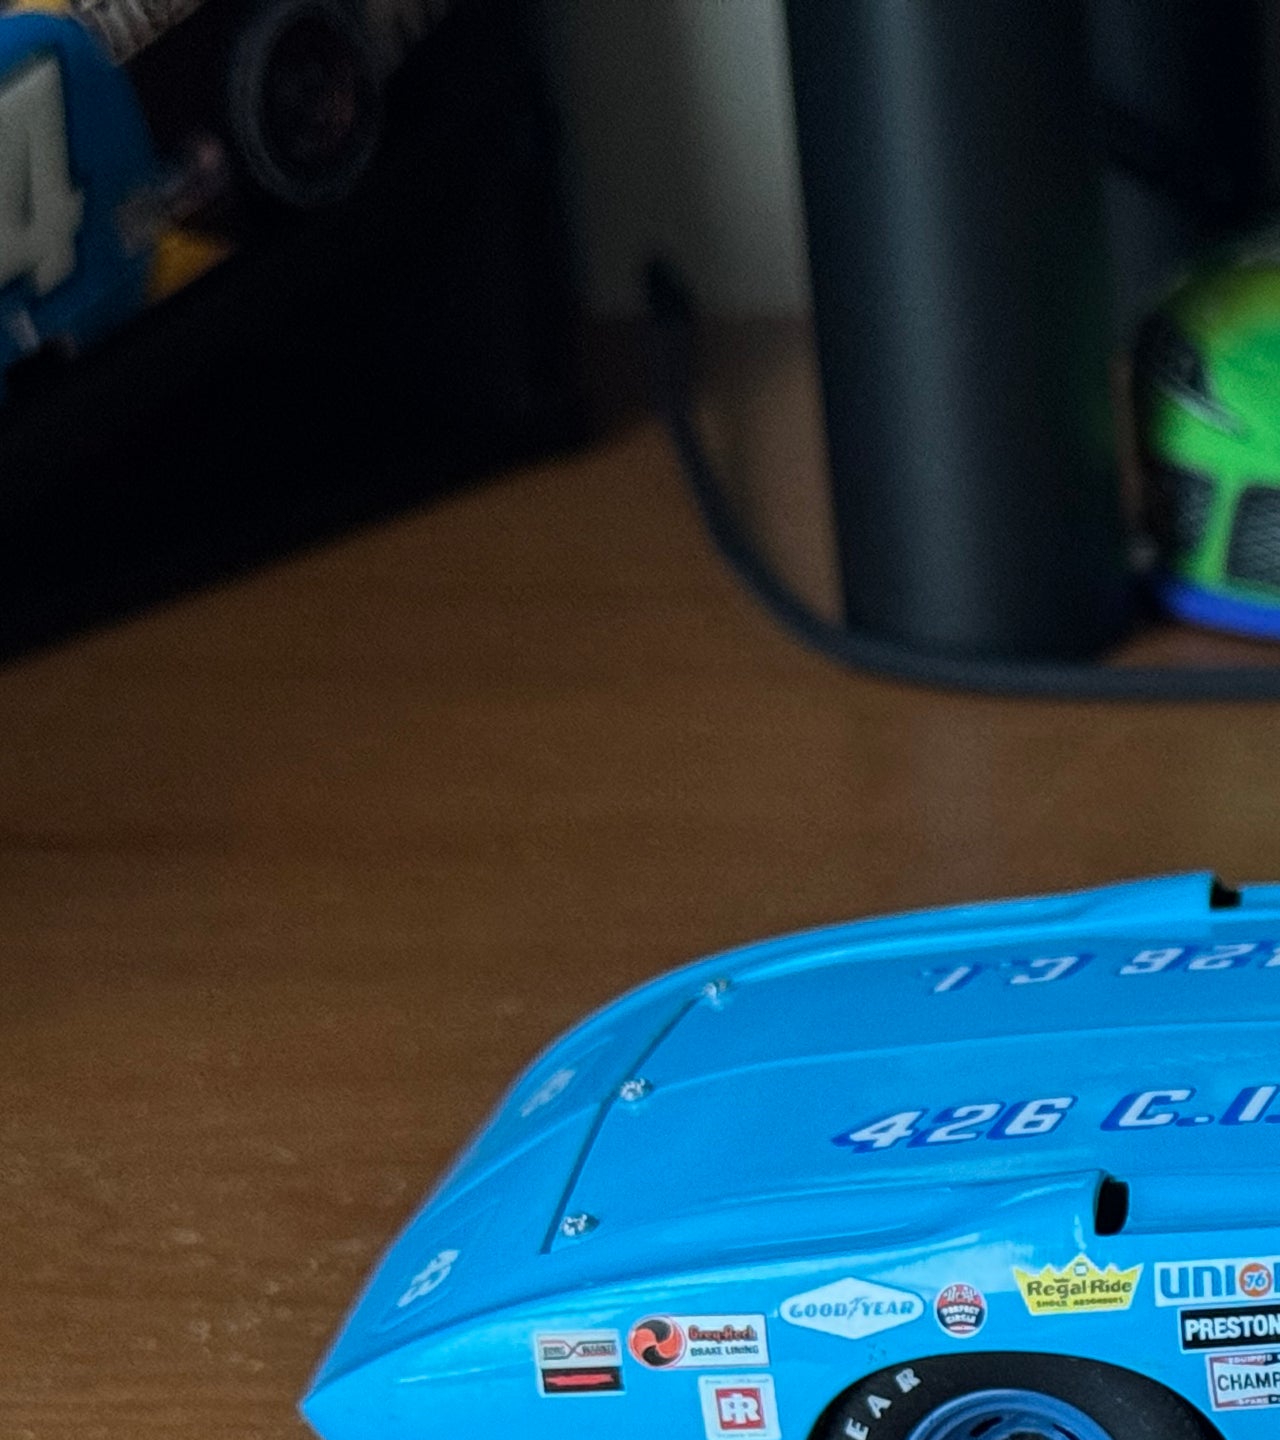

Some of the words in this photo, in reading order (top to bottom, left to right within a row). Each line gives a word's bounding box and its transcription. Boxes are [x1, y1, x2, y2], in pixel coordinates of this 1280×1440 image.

[832, 1094, 1077, 1153] 426
[1026, 1279, 1087, 1299] Regal
[1090, 1278, 1132, 1294] Ride
